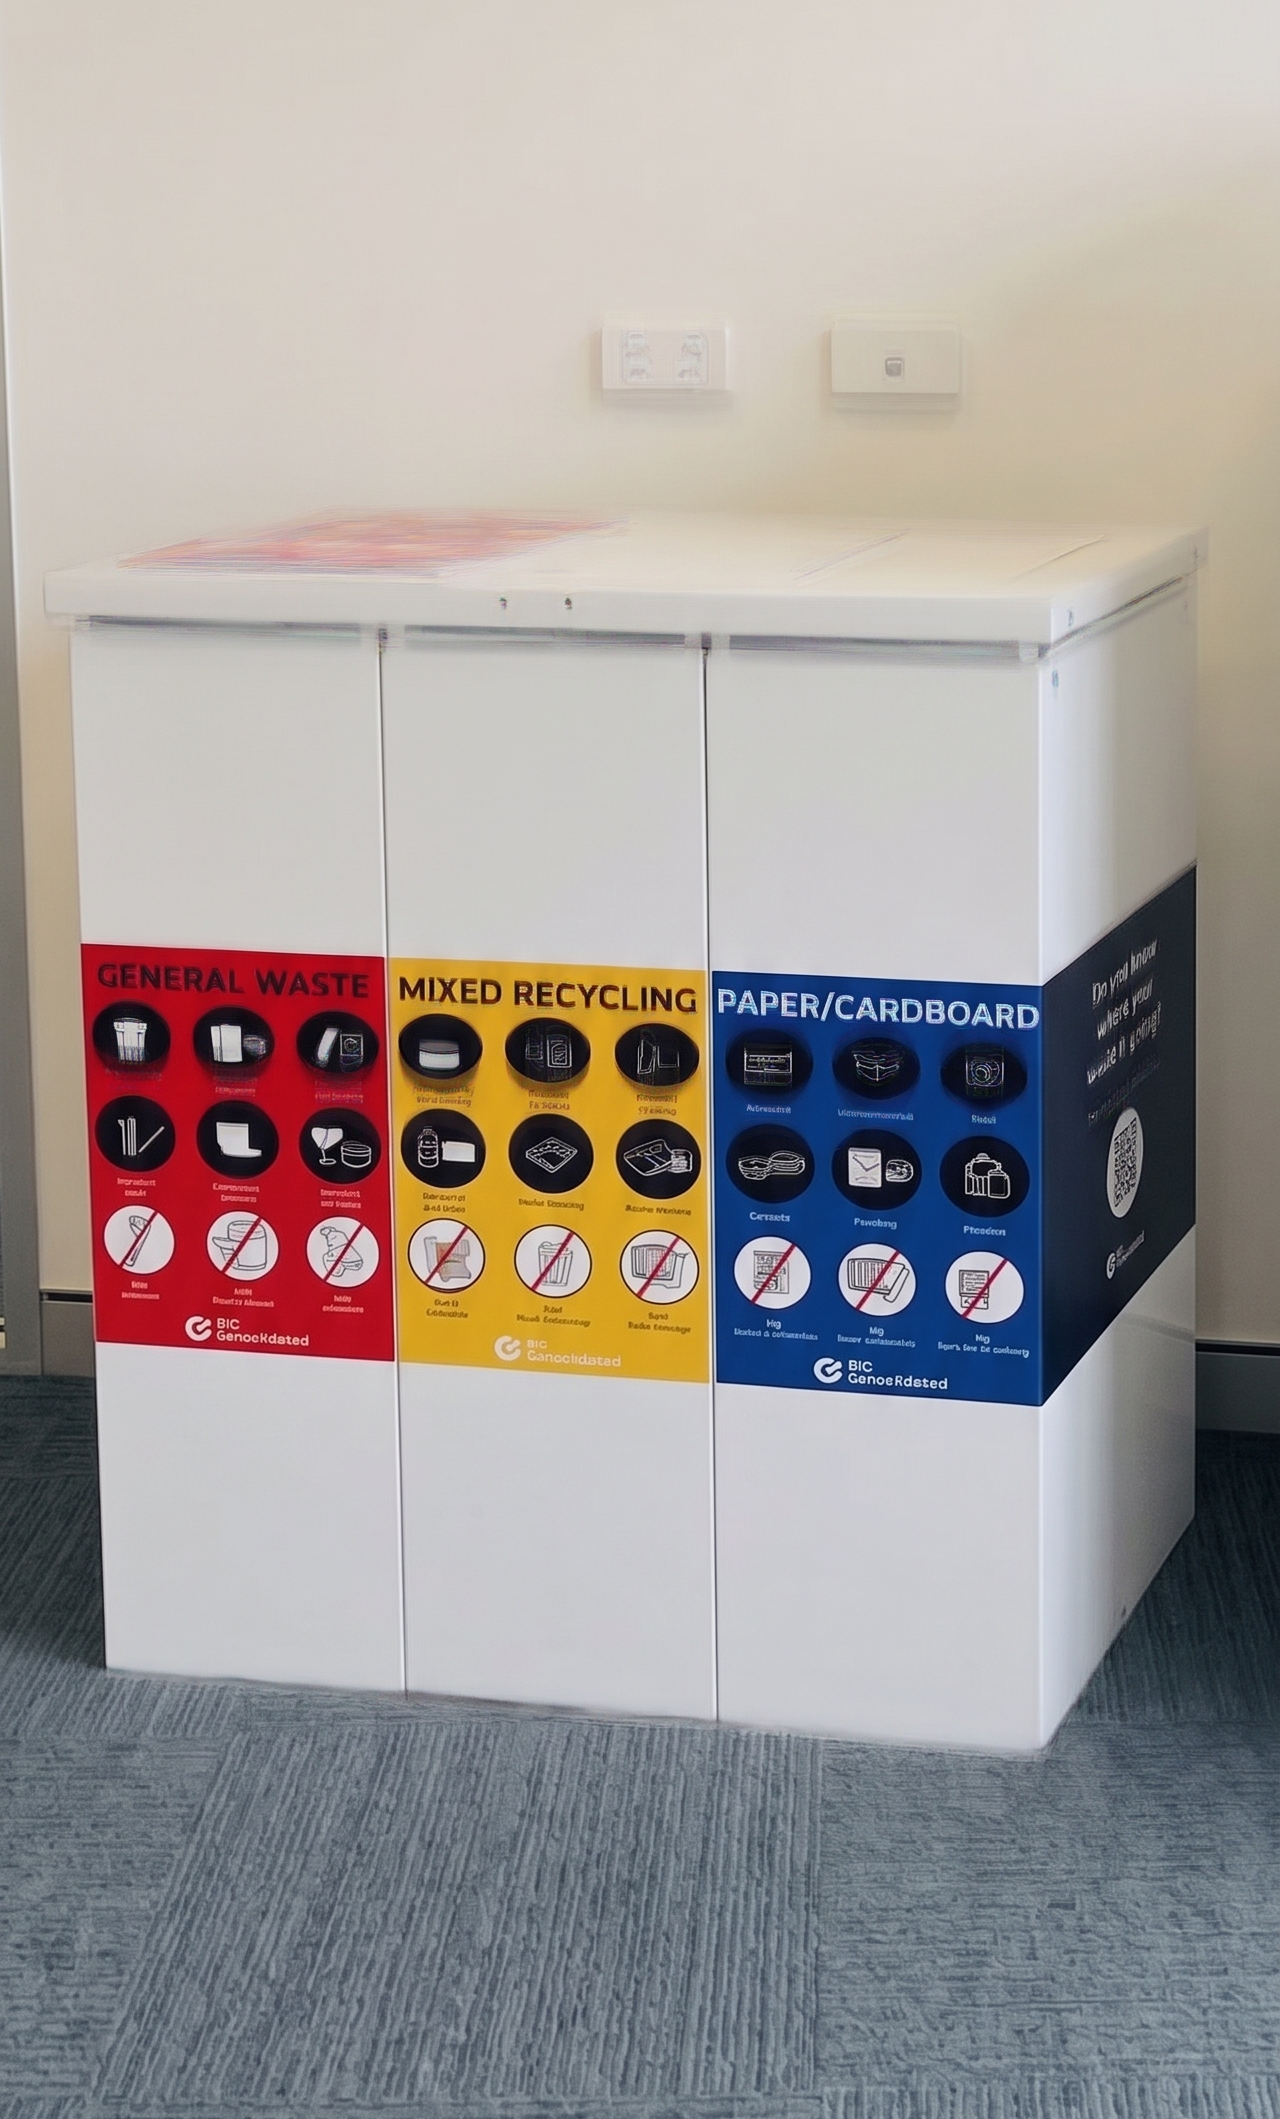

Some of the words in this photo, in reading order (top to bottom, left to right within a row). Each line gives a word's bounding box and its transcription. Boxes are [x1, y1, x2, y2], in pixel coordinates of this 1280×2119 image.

[98, 963, 245, 994] GENERAL
[255, 969, 370, 999] WASTE
[399, 976, 502, 1005] MIXED
[514, 980, 697, 1013] RECYCLING
[717, 988, 1040, 1029] PAPER/CARDBOARD
[217, 1318, 240, 1330] BIC
[527, 1340, 547, 1349] BIC
[848, 1360, 873, 1372] BIC
